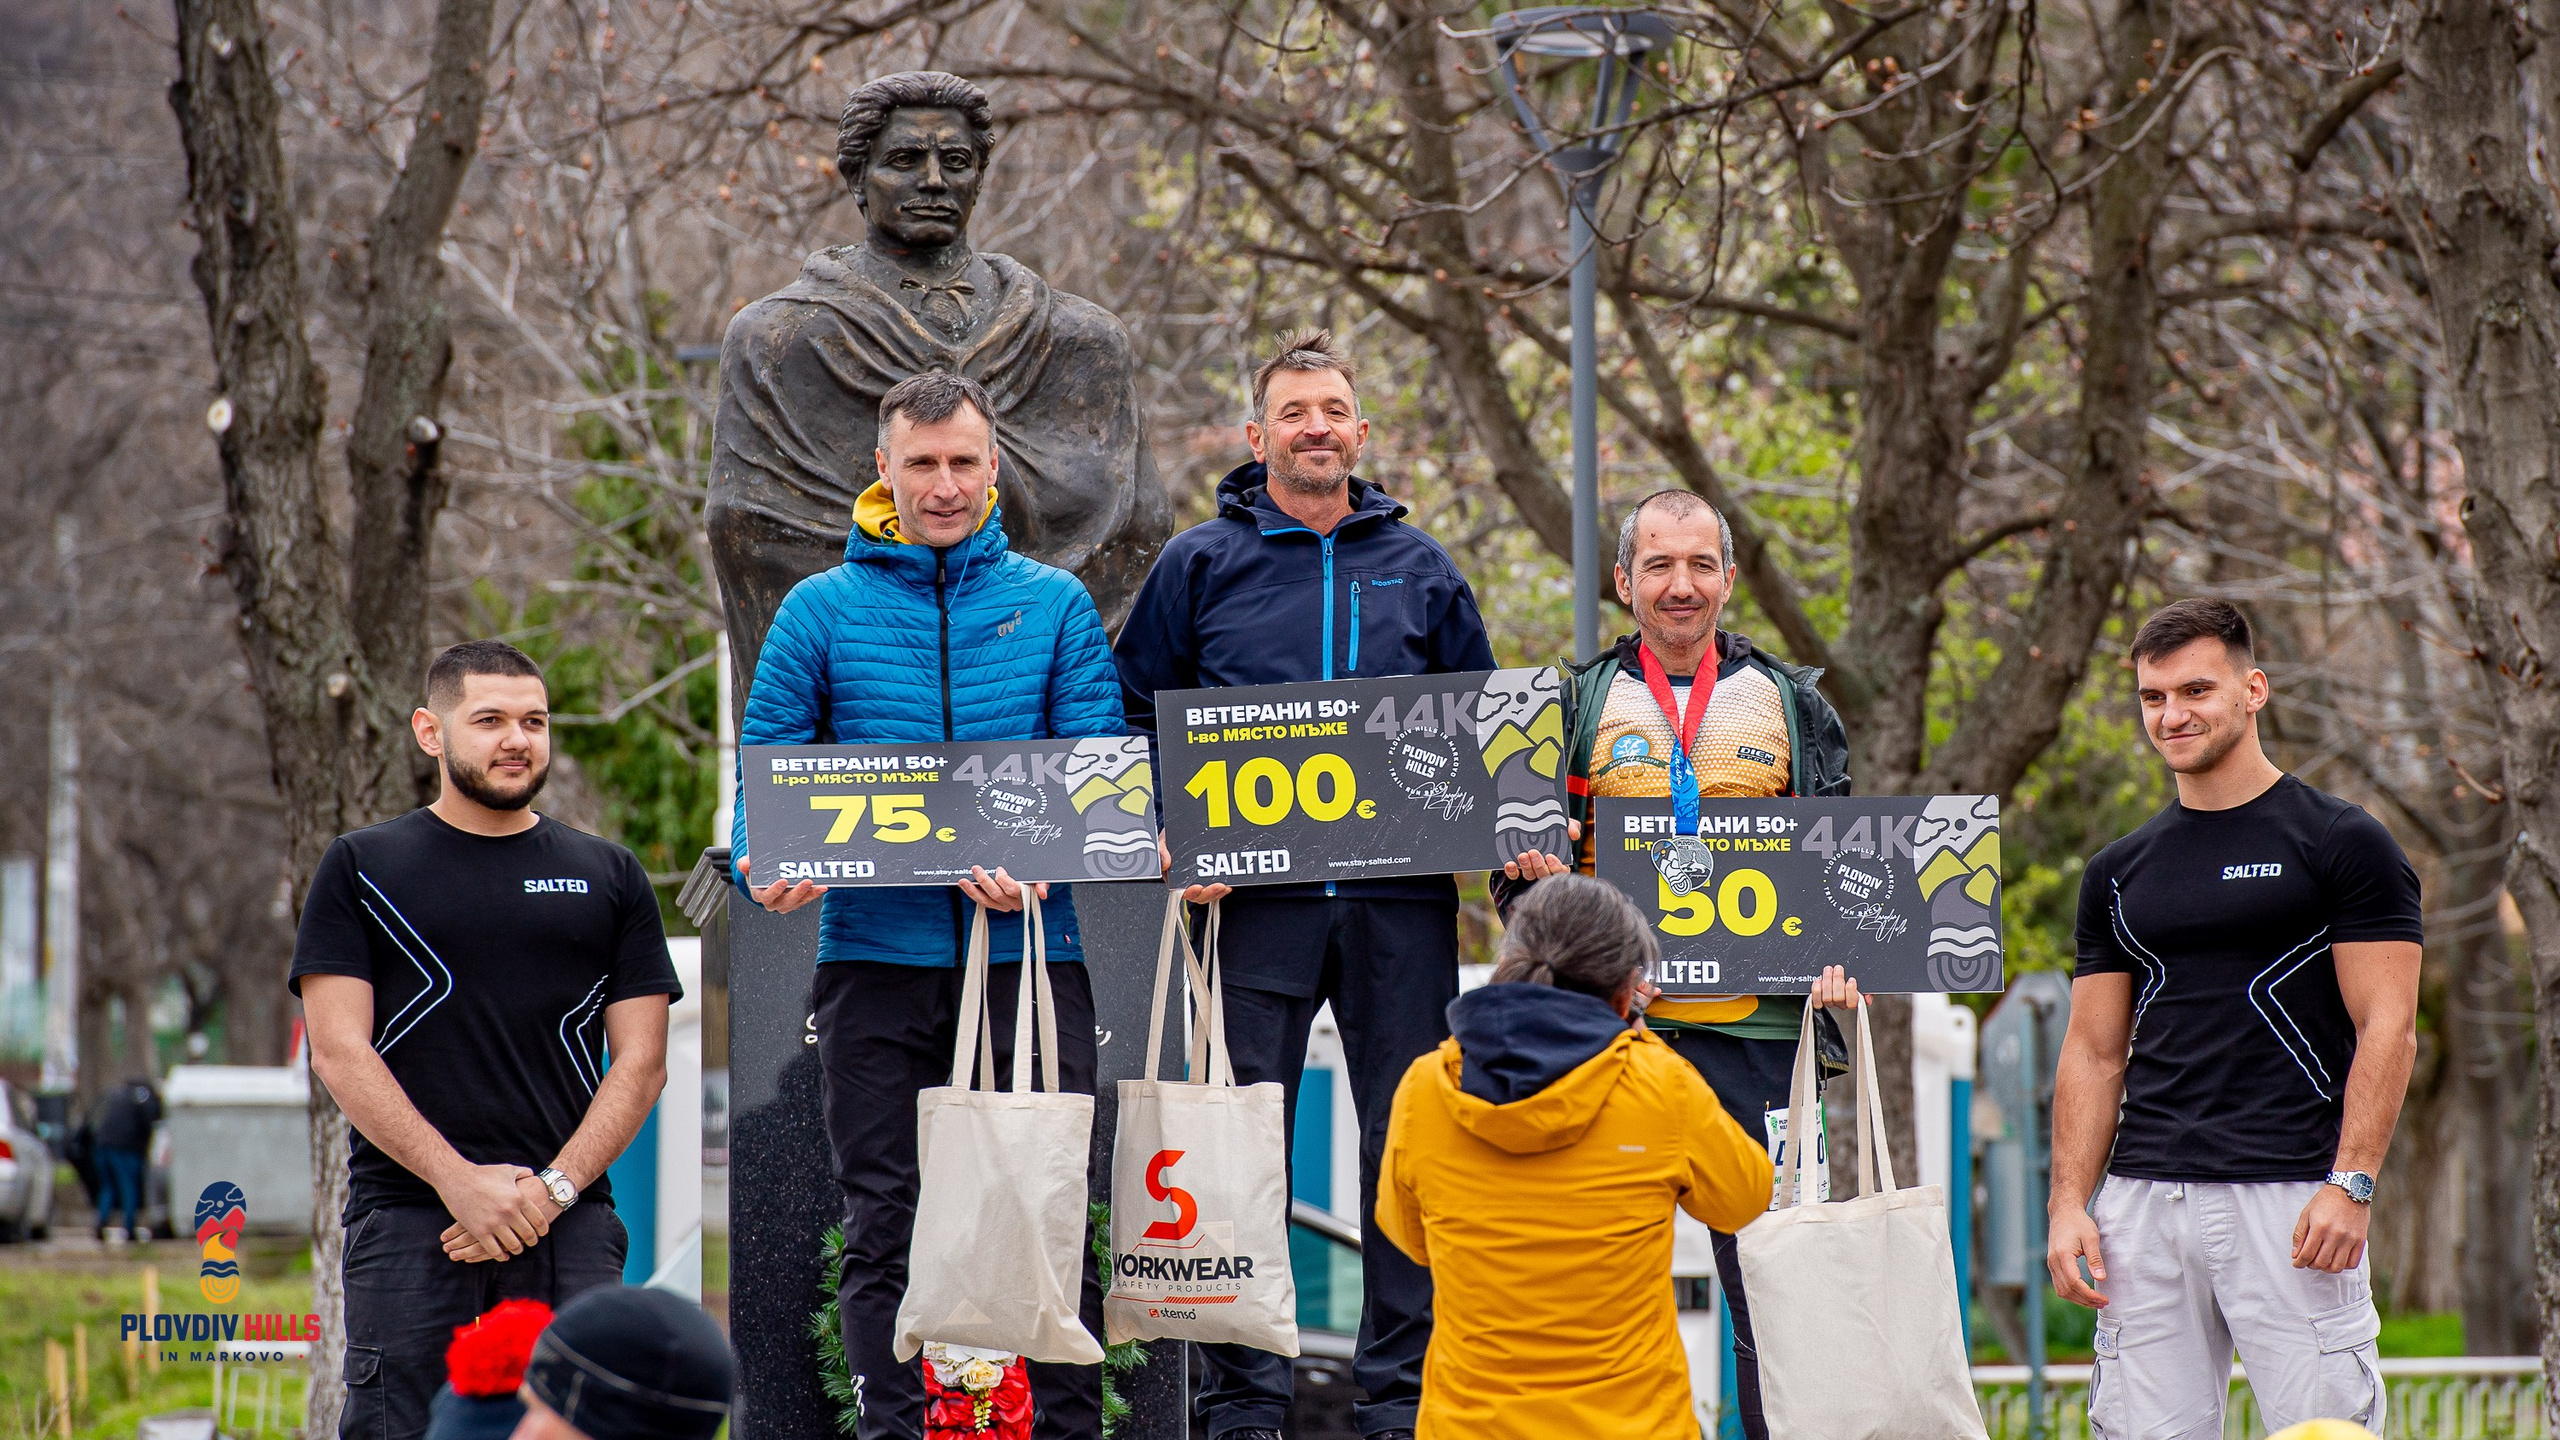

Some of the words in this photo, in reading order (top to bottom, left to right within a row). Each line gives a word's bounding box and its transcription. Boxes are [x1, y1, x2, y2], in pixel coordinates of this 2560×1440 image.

[1185, 701, 1313, 726] ВЕТЕРАНИ
[1318, 699, 1360, 718] 50+
[1364, 690, 1480, 741] 44K
[1223, 725, 1288, 742] МЯСТО
[1290, 721, 1348, 738] МЪЖЕ
[771, 757, 899, 772] ВЕТЕРАНИ
[905, 756, 949, 769] 50+
[1402, 744, 1448, 768] PLOVDIV
[813, 772, 878, 784] МЯСТО
[881, 771, 939, 783] МЪЖЕ
[952, 752, 1067, 787] 44K
[1388, 767, 1404, 788] TRAIL
[1405, 758, 1436, 779] HILLS
[989, 789, 1037, 808] PLOVDIV
[992, 800, 1024, 815] HILLS
[1624, 815, 1750, 834] ВЕТЕАНИ
[1755, 815, 1798, 834] 50+
[1734, 837, 1791, 852] МЪЖЕ
[1801, 815, 1918, 860] 44K
[779, 860, 876, 879] SALTED
[1196, 849, 1291, 877] SALTED
[1328, 855, 1411, 869] www.stay-salted.com
[2222, 863, 2282, 880] SALTED
[1824, 848, 1849, 874] PLOVDIV
[1852, 847, 1875, 856] HILLS
[1884, 863, 1895, 900] MARKOVO
[1838, 864, 1883, 890] PLOVDIV
[523, 879, 589, 894] SALTED
[1840, 879, 1870, 899] HILLS
[1824, 886, 1838, 908] TRAIL
[1117, 1280, 1160, 1291] SAFETY
[1168, 1283, 1241, 1293] PRODUCTS
